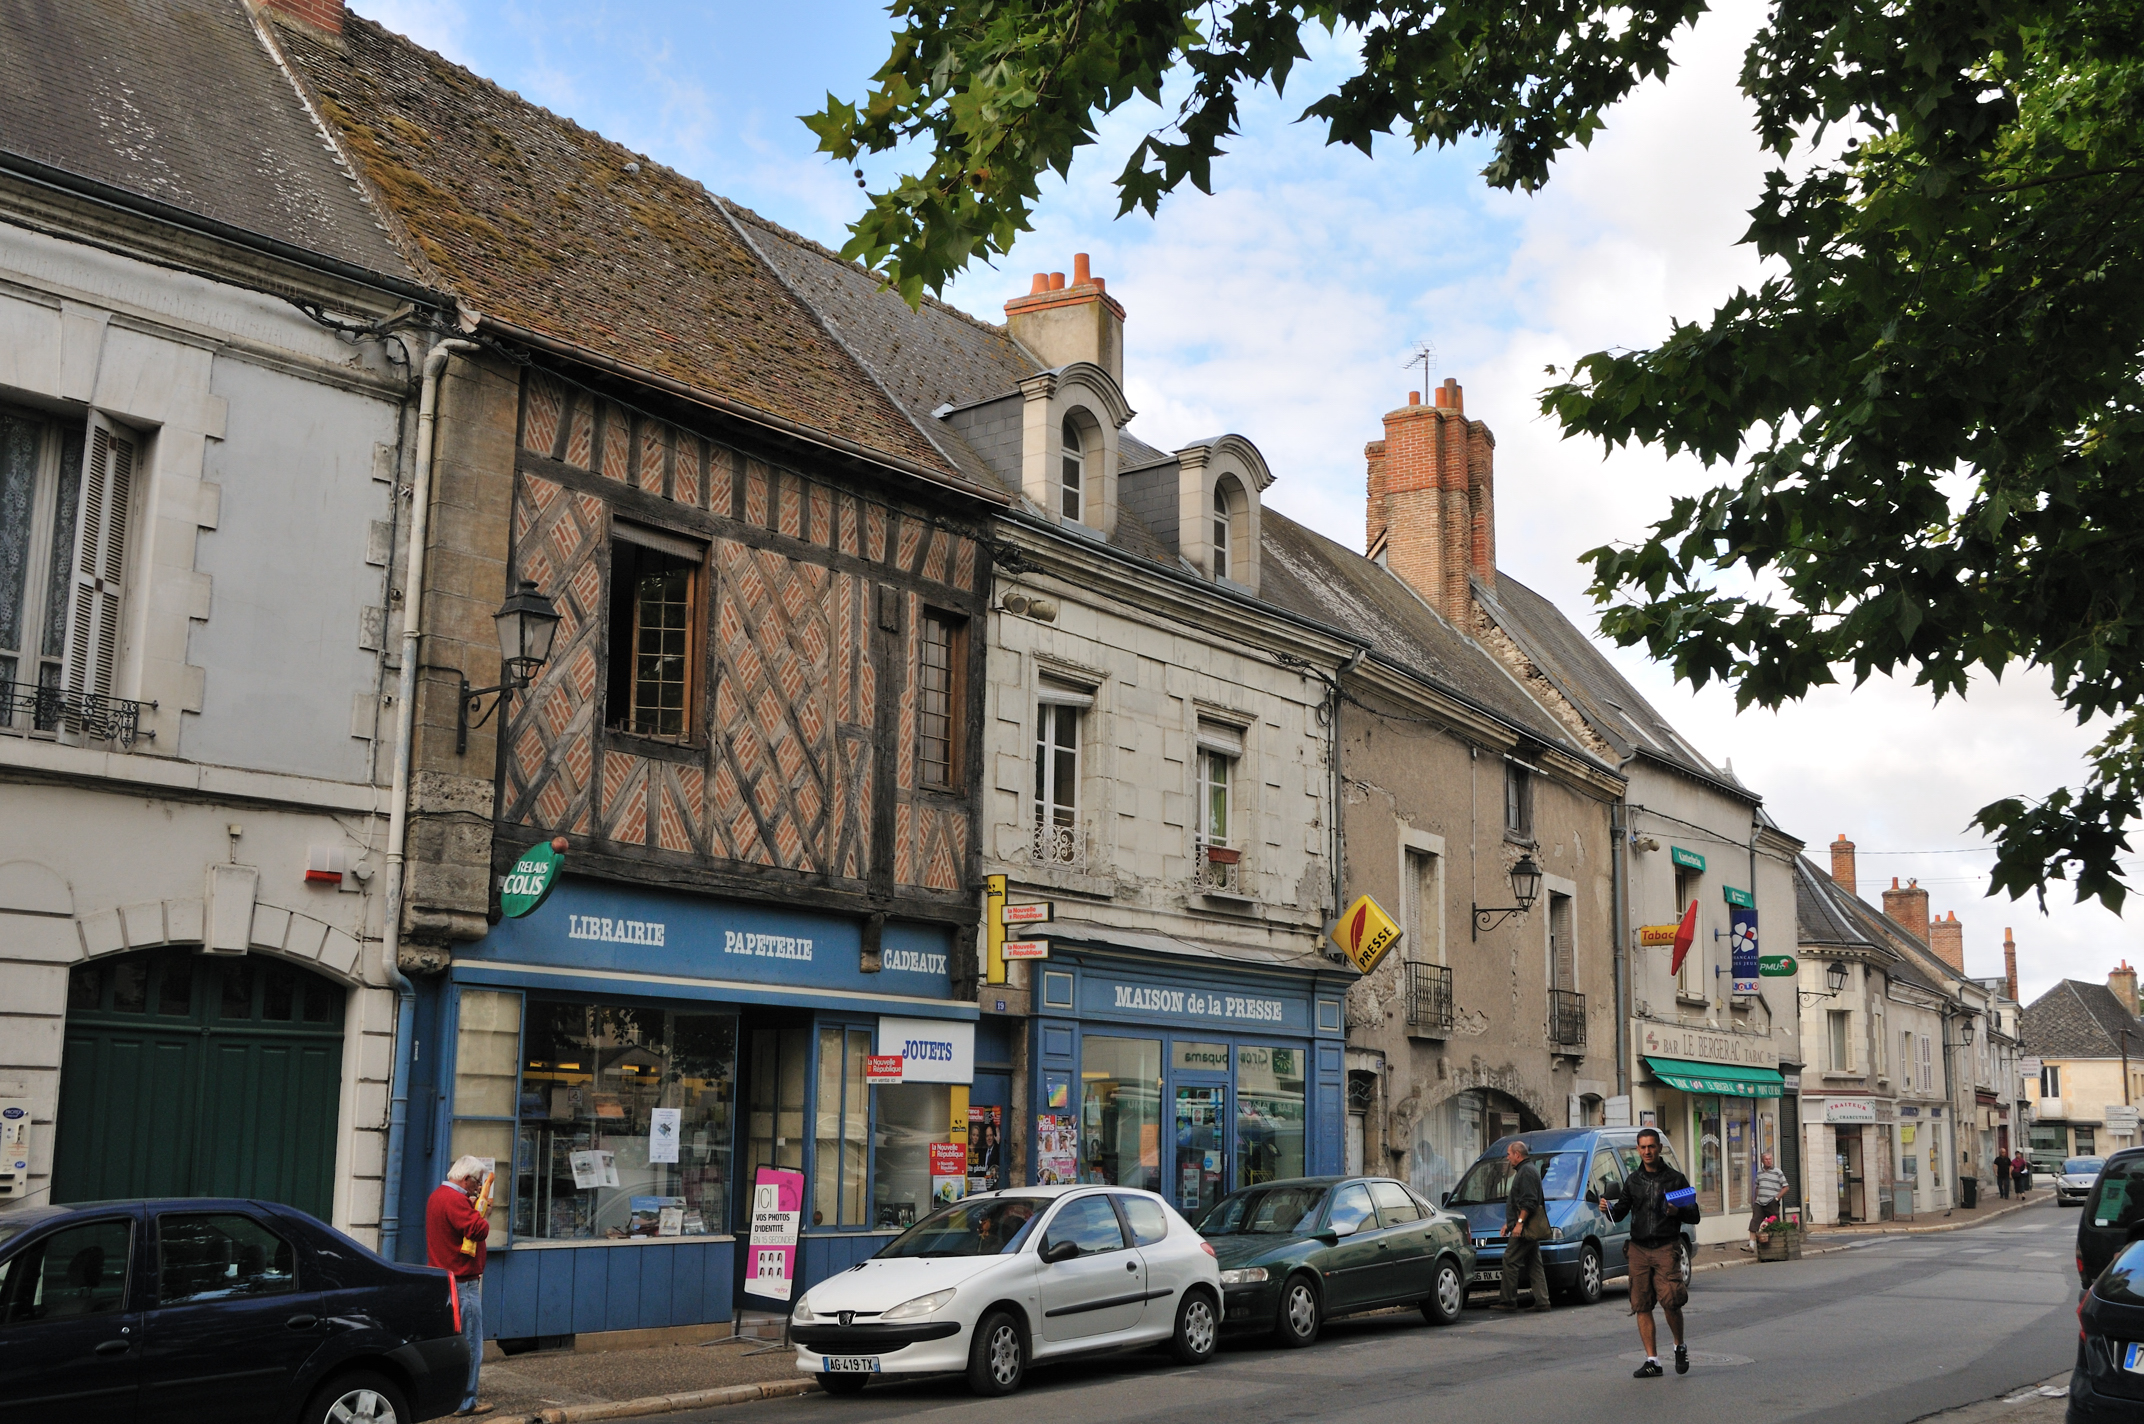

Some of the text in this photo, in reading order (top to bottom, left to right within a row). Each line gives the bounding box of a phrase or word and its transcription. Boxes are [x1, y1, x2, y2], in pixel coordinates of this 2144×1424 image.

[517, 861, 549, 874] RELAIS
[503, 874, 546, 896] COLIS
[1013, 912, 1043, 920] République
[568, 914, 665, 947] LIBRAIRIE
[1641, 930, 1674, 941] Tabac
[724, 930, 813, 962] PAPETERIE
[1358, 926, 1393, 968] PRESSE
[1013, 949, 1043, 957] République
[883, 949, 947, 975] CADEAUX
[1759, 963, 1779, 971] PMU
[1733, 981, 1759, 991] LOTO
[1115, 985, 1283, 1022] MAISON de la PRESSE
[902, 1040, 953, 1061] JOUETS
[1663, 1039, 1679, 1055] BAR
[1683, 1033, 1694, 1056] LE
[1698, 1035, 1740, 1062] BERGERAC
[1744, 1048, 1764, 1063] TABAC
[873, 1058, 896, 1067] Nouvelle
[873, 1065, 902, 1074] République
[1830, 1102, 1867, 1111] TRAITEUR
[937, 1143, 958, 1151] Nouvelle
[937, 1150, 964, 1159] République
[757, 1187, 772, 1209] ICI
[756, 1213, 790, 1222] VOS PHOTOS
[755, 1224, 784, 1233] D'IDENTITÉ
[753, 1235, 796, 1244] EN 15 SECONDES
[1483, 1271, 1493, 1280] RX
